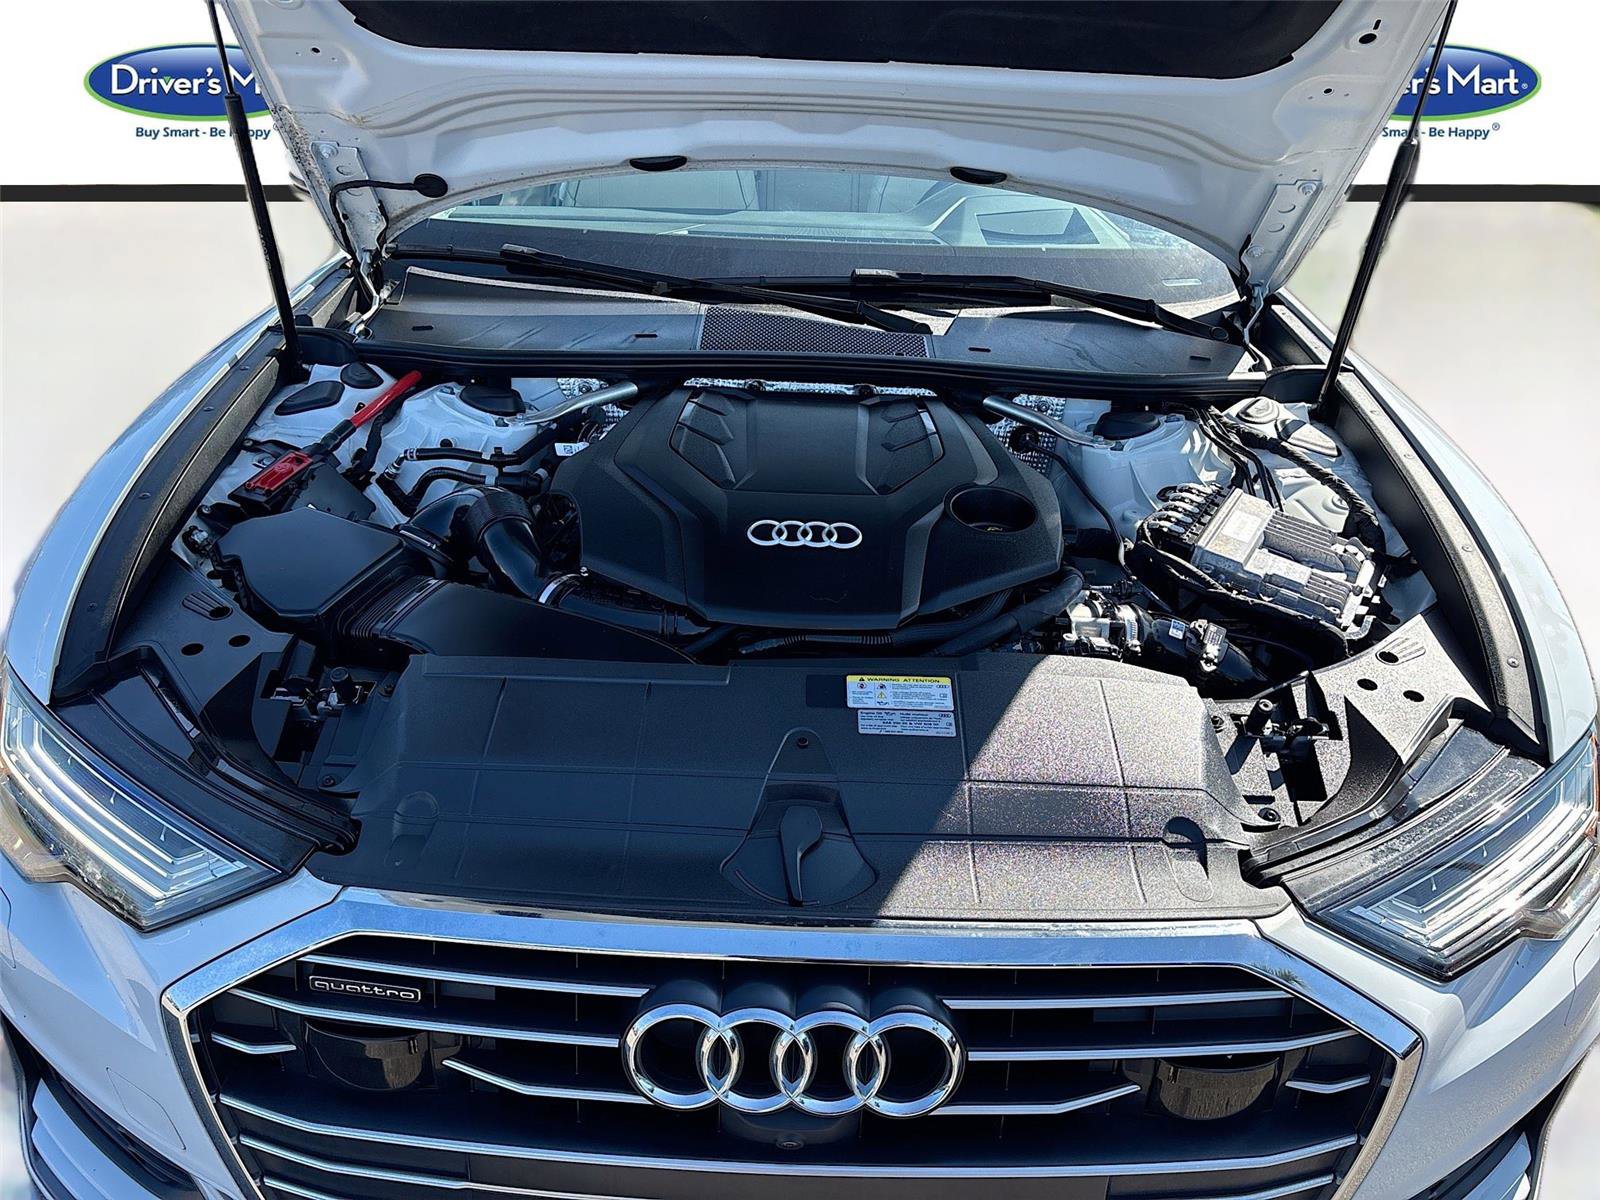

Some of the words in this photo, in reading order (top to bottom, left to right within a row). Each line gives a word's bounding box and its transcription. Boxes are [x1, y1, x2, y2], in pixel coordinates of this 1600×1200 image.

[111, 64, 222, 95] Driver's
[136, 126, 160, 140] Buy
[163, 126, 200, 138] Smart
[210, 127, 226, 138] Be
[1429, 127, 1445, 138] Be
[1448, 127, 1490, 140] Happy
[314, 980, 415, 999] quattro
